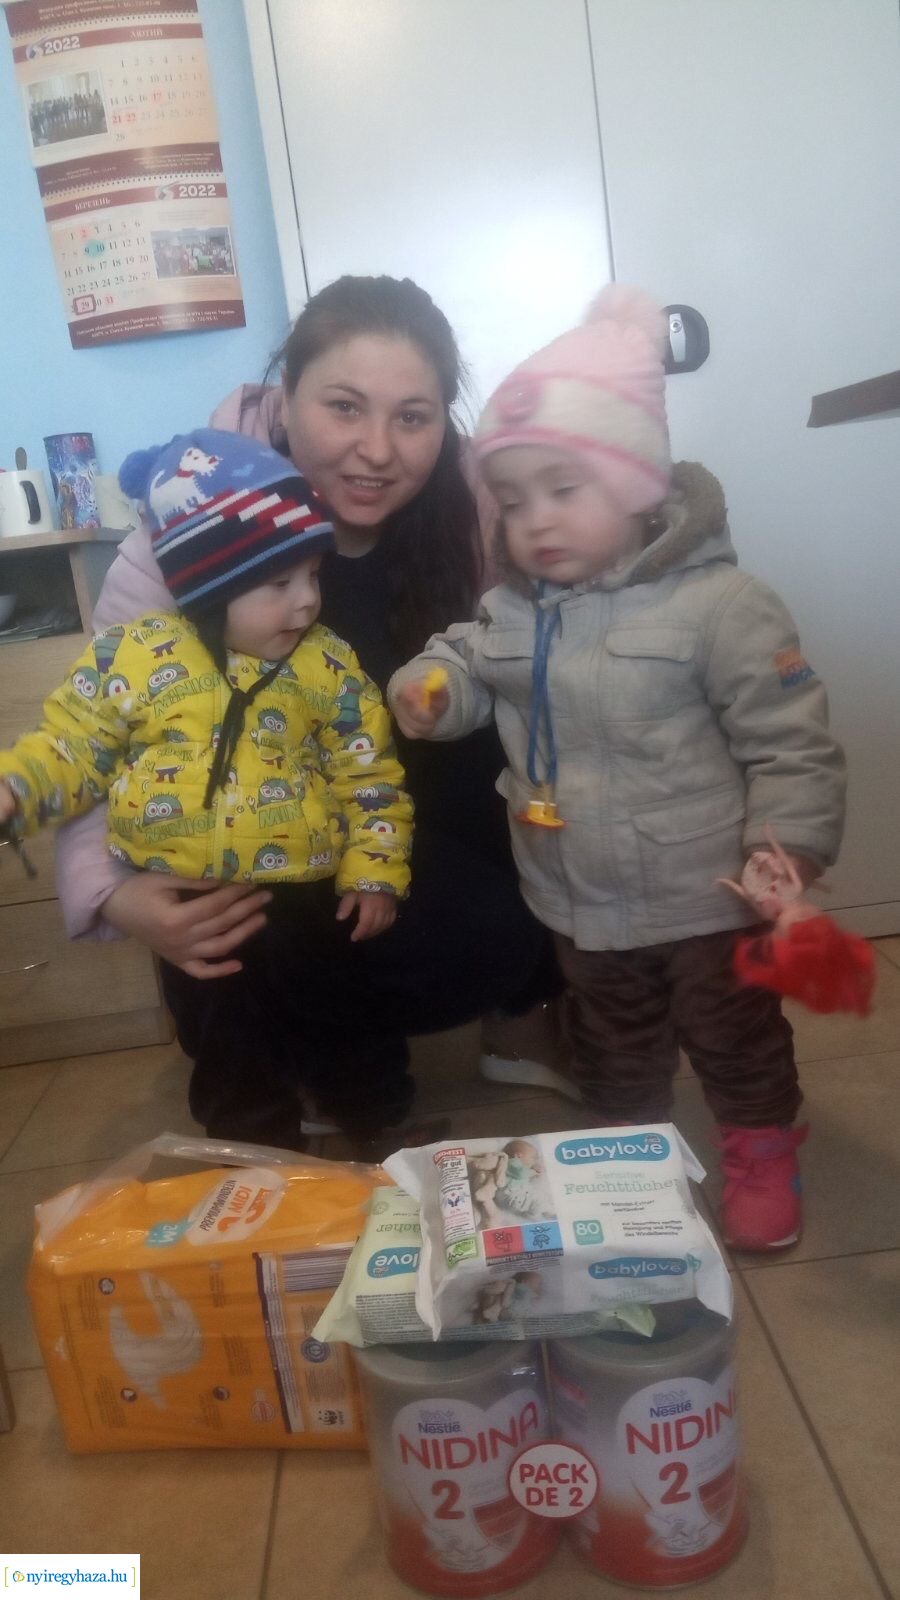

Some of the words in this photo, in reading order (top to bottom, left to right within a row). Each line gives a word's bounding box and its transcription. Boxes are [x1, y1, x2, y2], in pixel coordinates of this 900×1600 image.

[44, 36, 81, 54] 2022
[179, 184, 217, 198] 2022
[562, 1141, 664, 1160] babylove
[576, 1222, 600, 1236] 80
[374, 1253, 419, 1268] love
[594, 1261, 682, 1276] babylove
[625, 1389, 737, 1455] NIDIN
[398, 1401, 539, 1470] NIDINA
[519, 1463, 589, 1484] PACK
[659, 1461, 691, 1505] 2
[431, 1479, 465, 1520] 2
[526, 1487, 559, 1506] DE
[569, 1487, 584, 1506] 2
